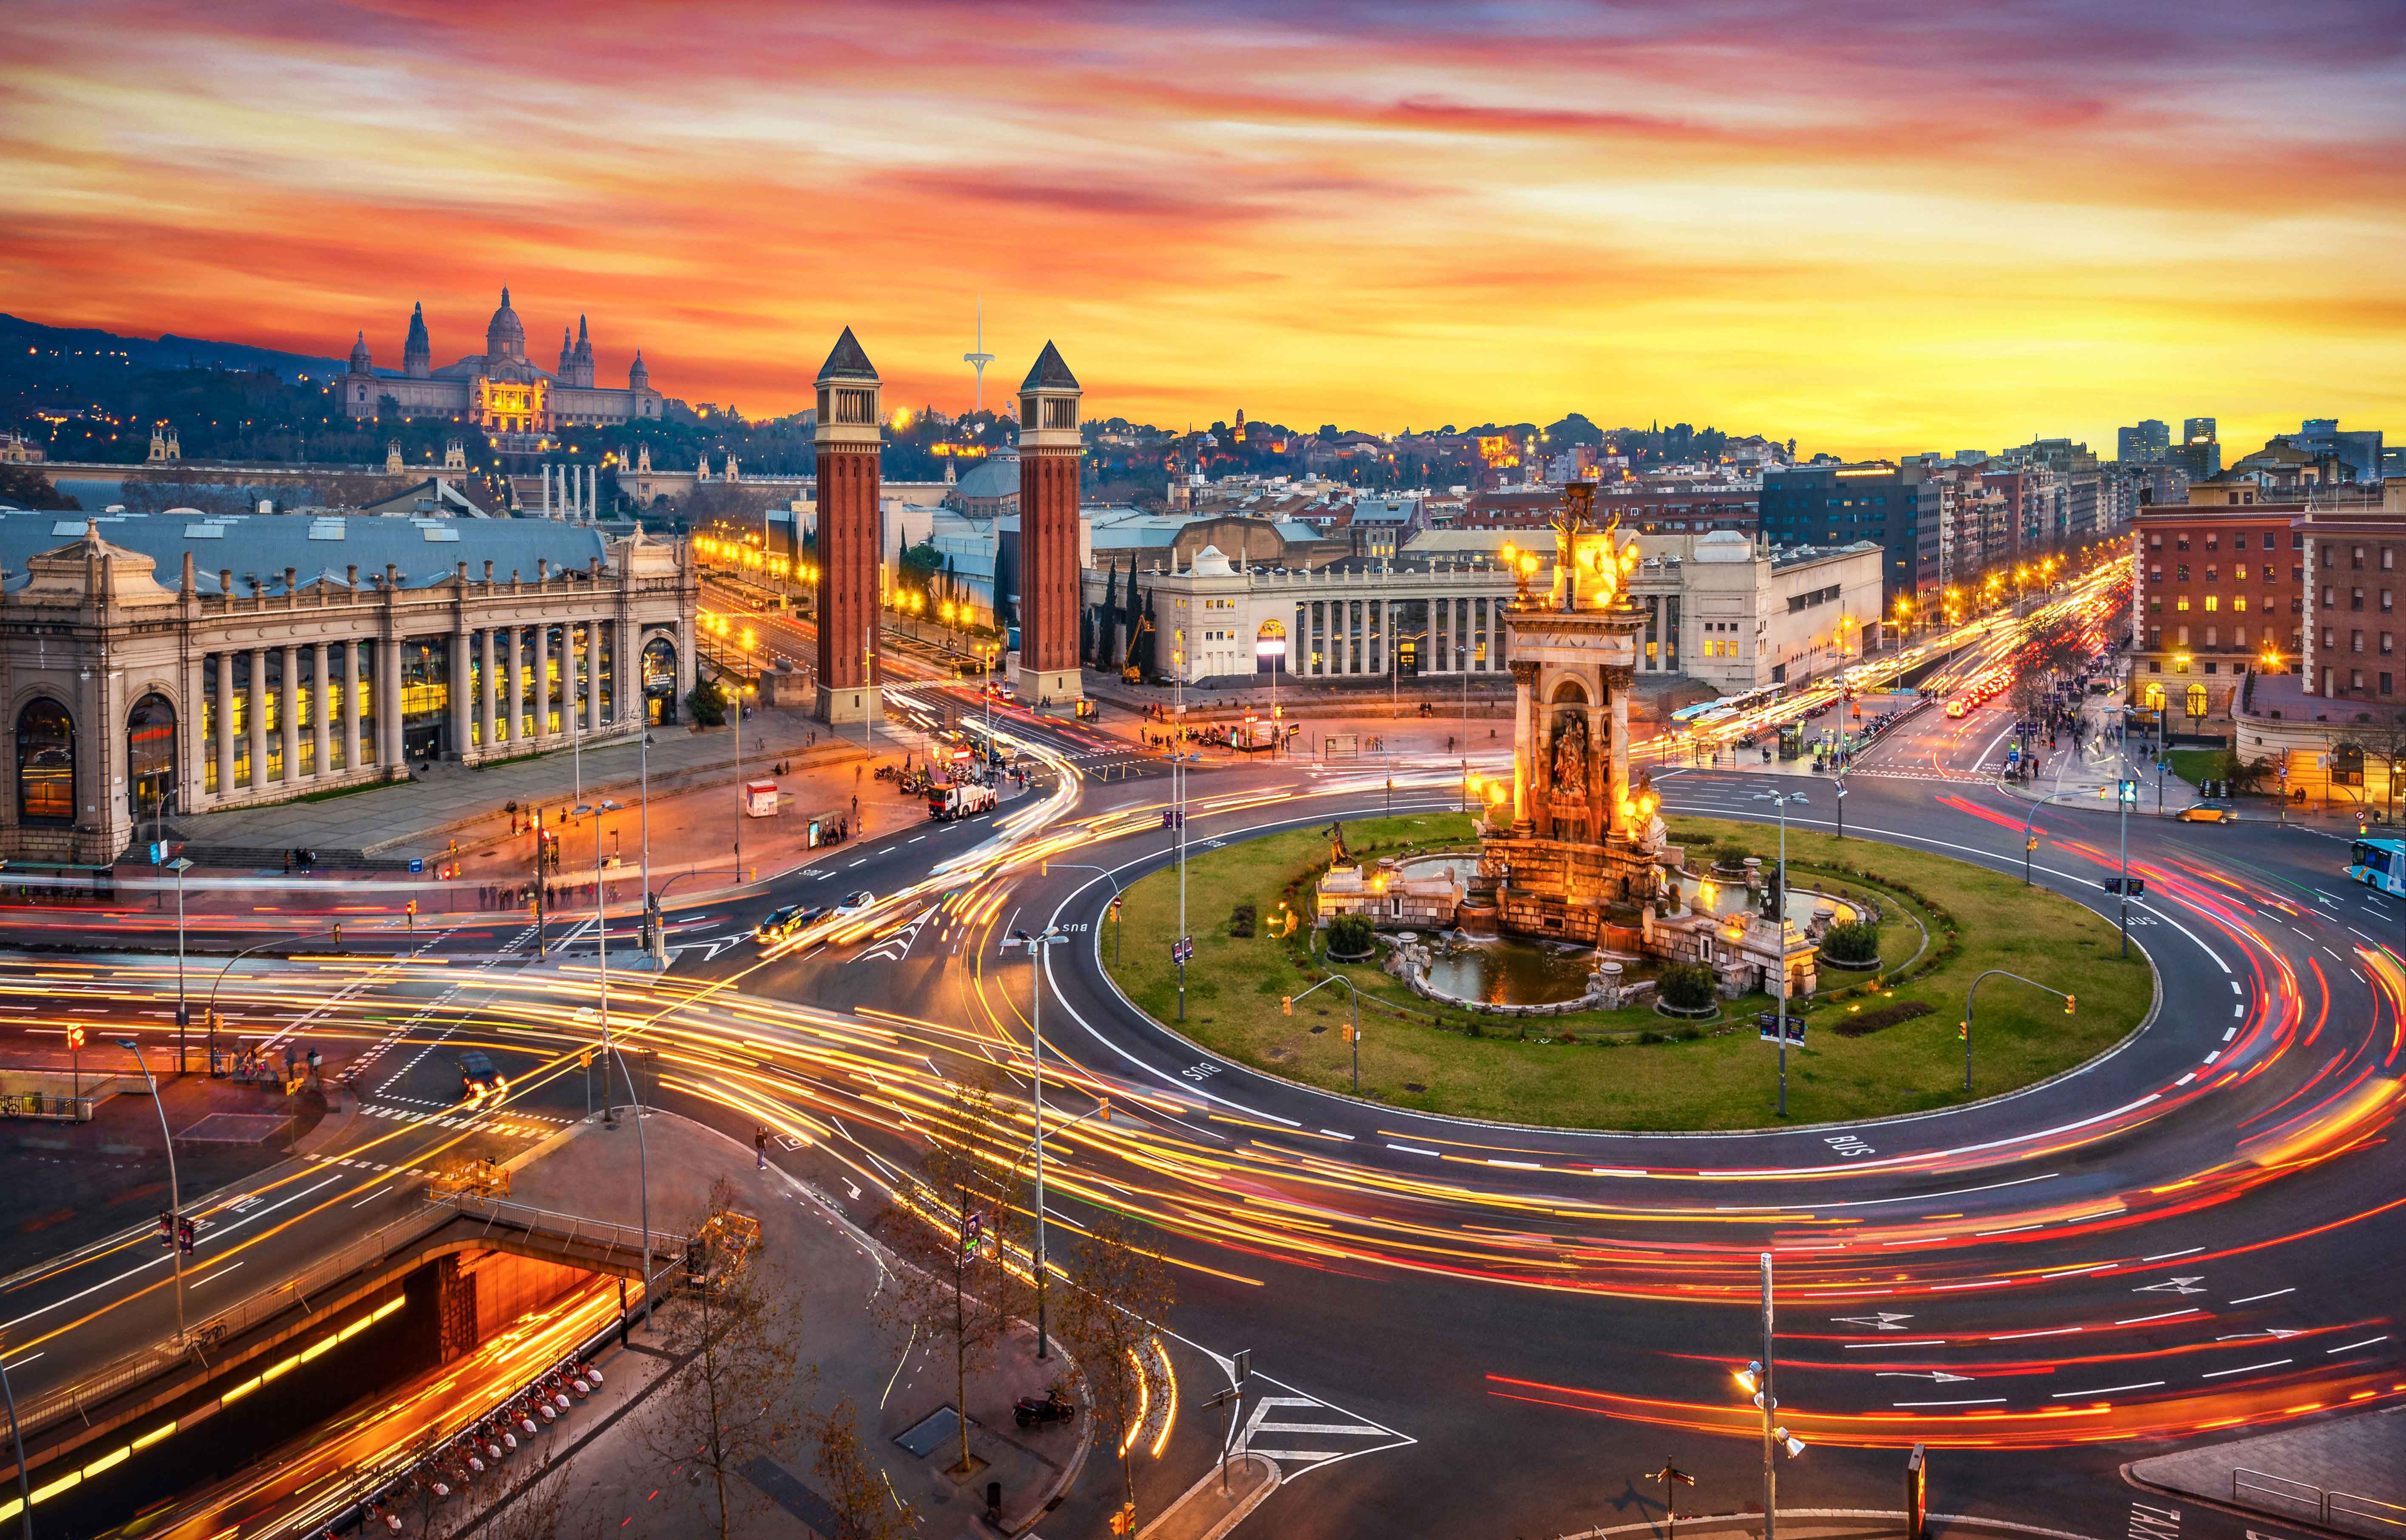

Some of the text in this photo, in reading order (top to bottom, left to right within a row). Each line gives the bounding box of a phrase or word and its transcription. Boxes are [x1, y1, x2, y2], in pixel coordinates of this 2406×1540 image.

[1062, 924, 1088, 932] BUS
[1182, 1062, 1222, 1081] BUS
[1823, 1135, 1876, 1156] BUS
